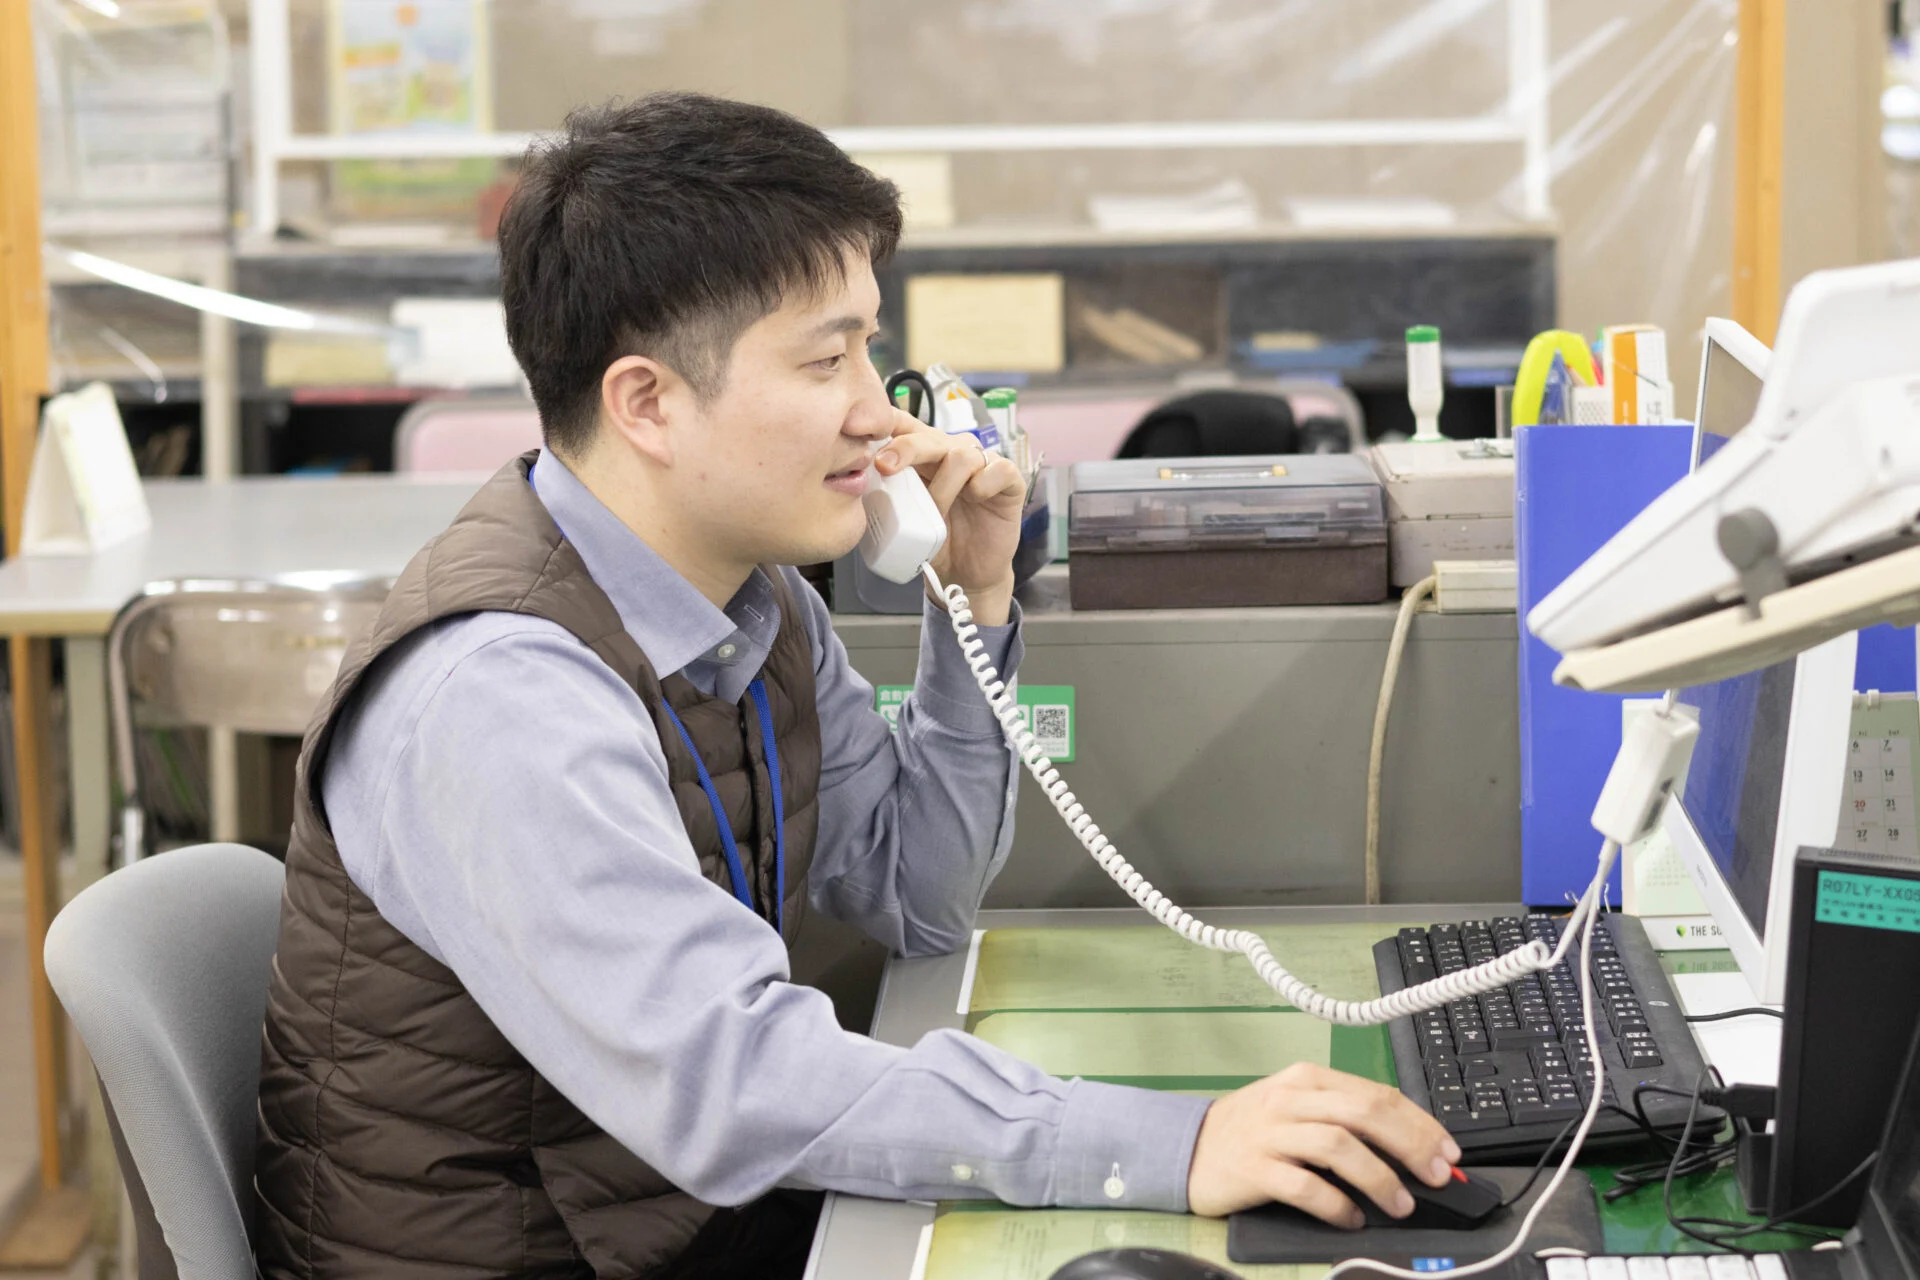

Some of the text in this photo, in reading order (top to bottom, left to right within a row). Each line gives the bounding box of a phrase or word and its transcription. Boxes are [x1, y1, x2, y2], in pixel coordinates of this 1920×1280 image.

[1884, 768, 1895, 777] 14
[1855, 800, 1866, 808] 20
[1857, 829, 1868, 838] 27
[1690, 925, 1707, 937] THE
